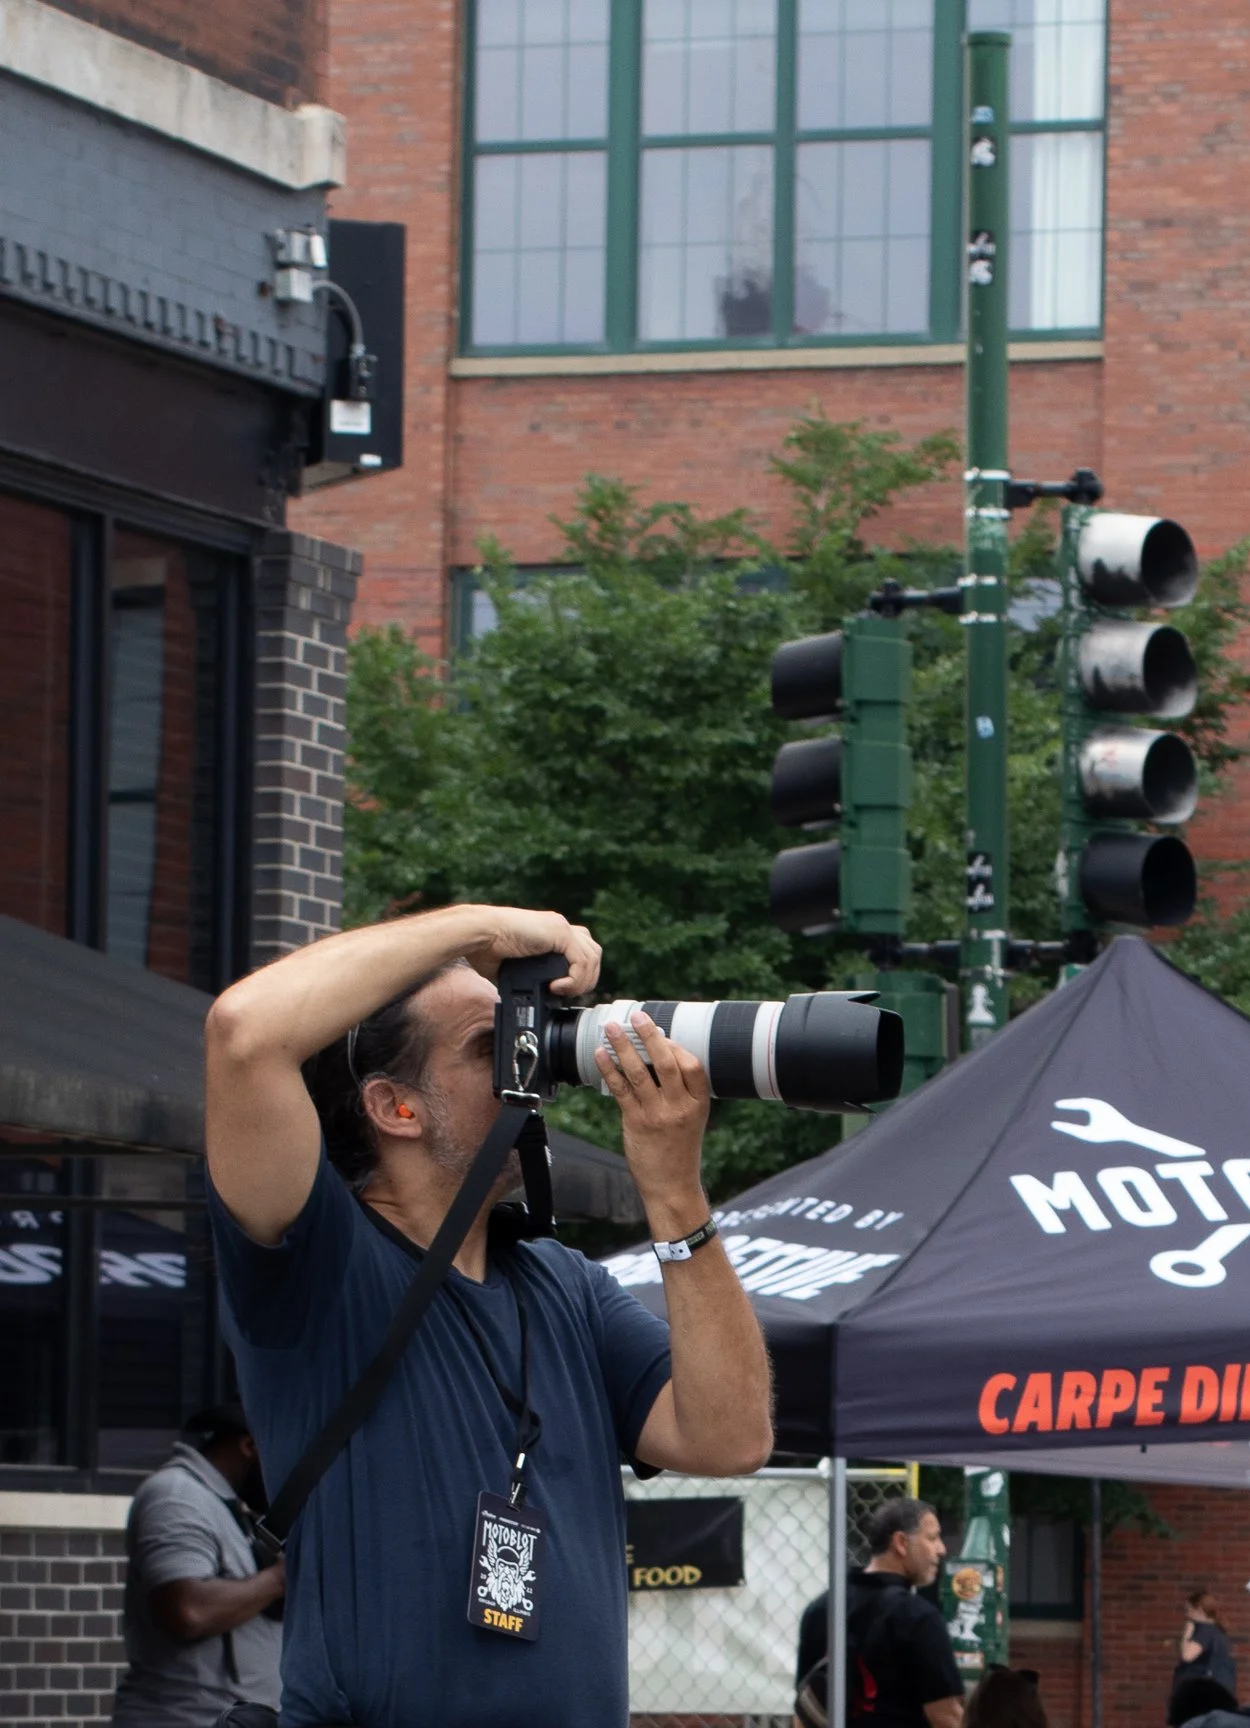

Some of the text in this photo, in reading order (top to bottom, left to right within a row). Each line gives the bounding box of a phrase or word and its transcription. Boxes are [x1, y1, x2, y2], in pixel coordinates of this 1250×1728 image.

[853, 1209, 904, 1231] BY
[978, 1366, 1170, 1435] CARPE
[482, 1519, 538, 1562] MOTOBLOT
[633, 1565, 702, 1587] FOOD
[483, 1608, 524, 1632] STAFF
